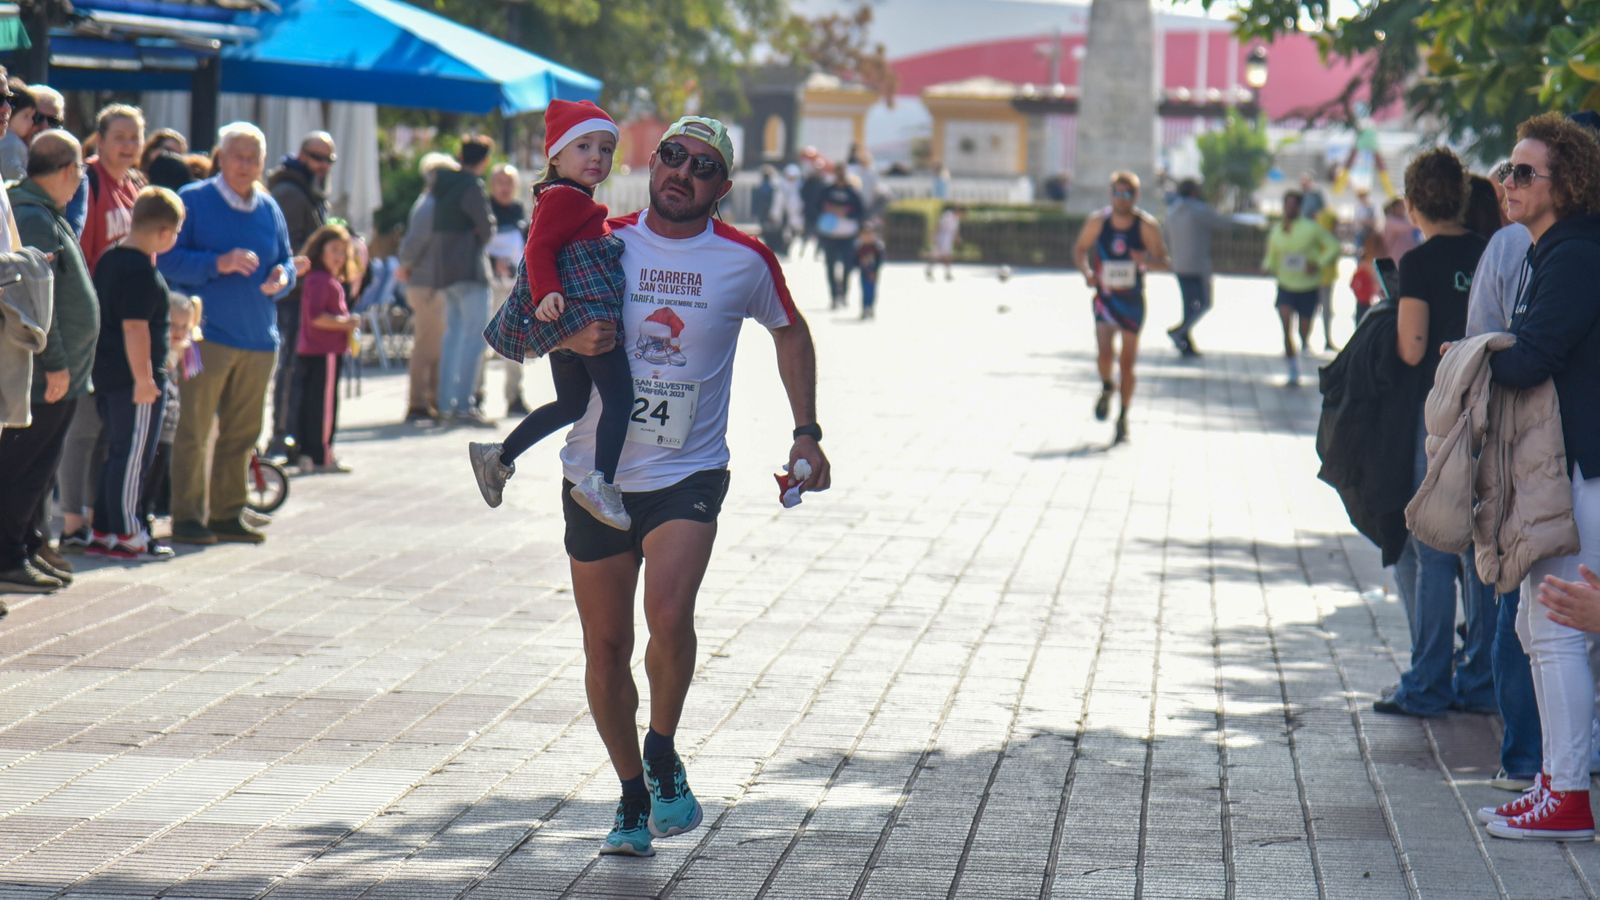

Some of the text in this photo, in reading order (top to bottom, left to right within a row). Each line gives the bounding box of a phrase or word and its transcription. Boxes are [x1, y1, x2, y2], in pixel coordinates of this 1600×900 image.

[640, 268, 702, 286] II CARRERA
[639, 281, 702, 296] SAN SILVESTRE
[665, 299, 693, 308] DICIEMBRE
[694, 301, 708, 309] 2023
[638, 386, 668, 396] TARIFEÑA
[654, 381, 695, 392] SILVESTRE
[630, 397, 670, 427] 24
